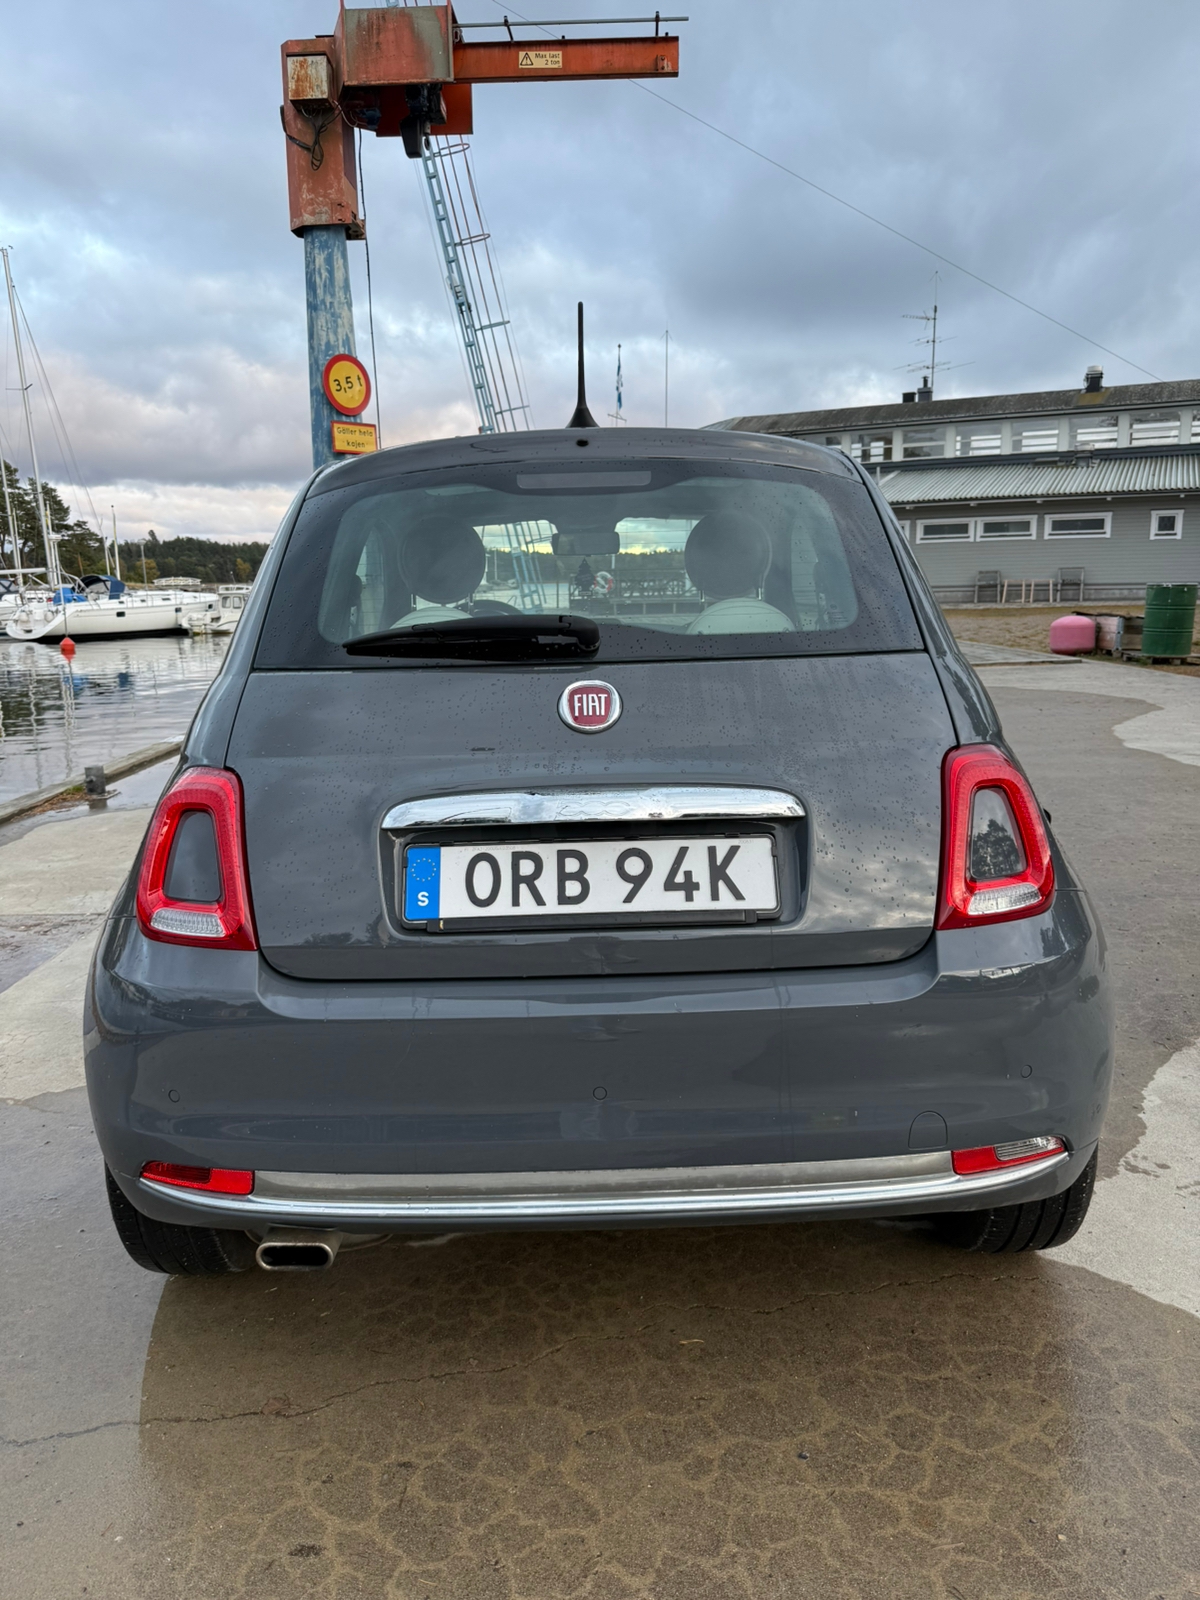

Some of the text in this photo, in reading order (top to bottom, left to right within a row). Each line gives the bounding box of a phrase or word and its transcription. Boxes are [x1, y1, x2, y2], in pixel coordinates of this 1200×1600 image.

[333, 374, 363, 393] 3,5 t
[358, 428, 373, 437] hela
[346, 440, 365, 449] kajen
[573, 693, 608, 717] FIAT
[465, 845, 746, 908] ORB 94K
[417, 891, 429, 907] S
